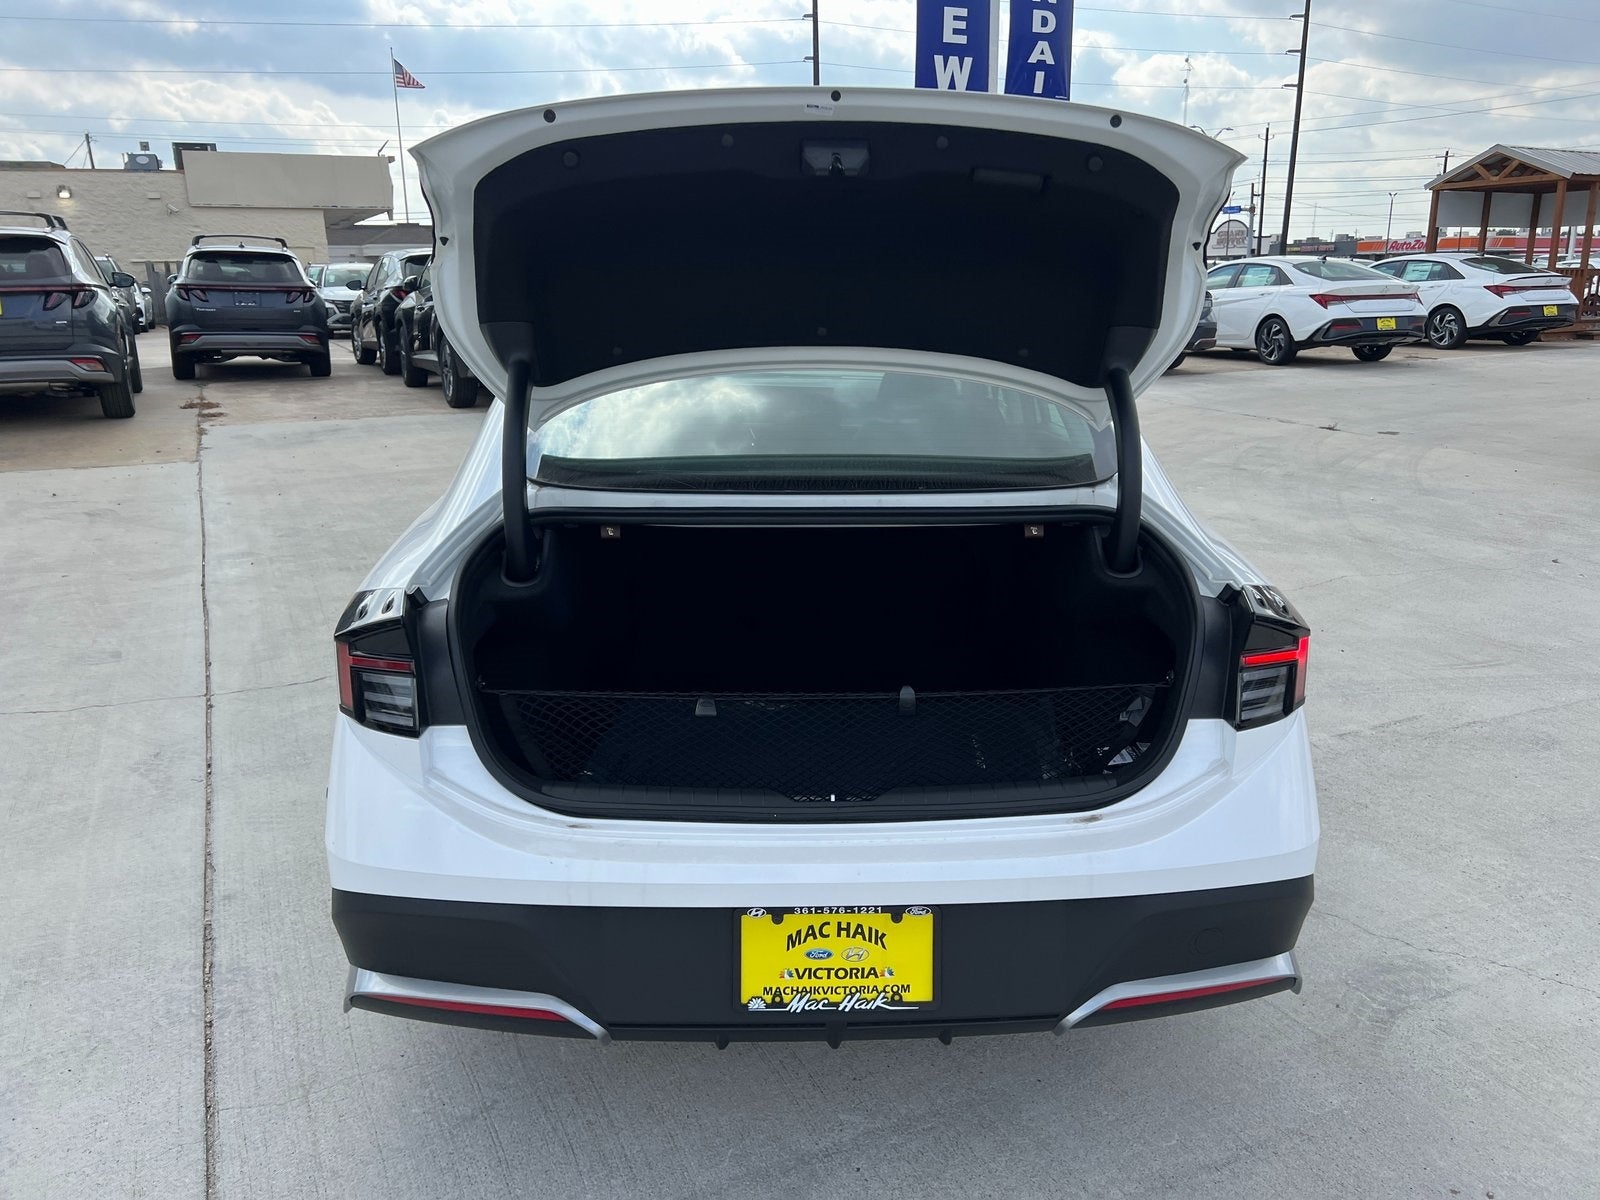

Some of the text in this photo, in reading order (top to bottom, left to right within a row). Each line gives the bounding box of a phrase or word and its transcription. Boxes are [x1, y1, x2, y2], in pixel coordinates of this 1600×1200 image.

[1027, 0, 1057, 94] DAI
[793, 906, 883, 915] 361-576-1221
[786, 921, 888, 952] MAC HAIK
[808, 950, 829, 959] Ford
[794, 967, 880, 980] VICTORIA
[786, 992, 895, 1013] Mac Haik
